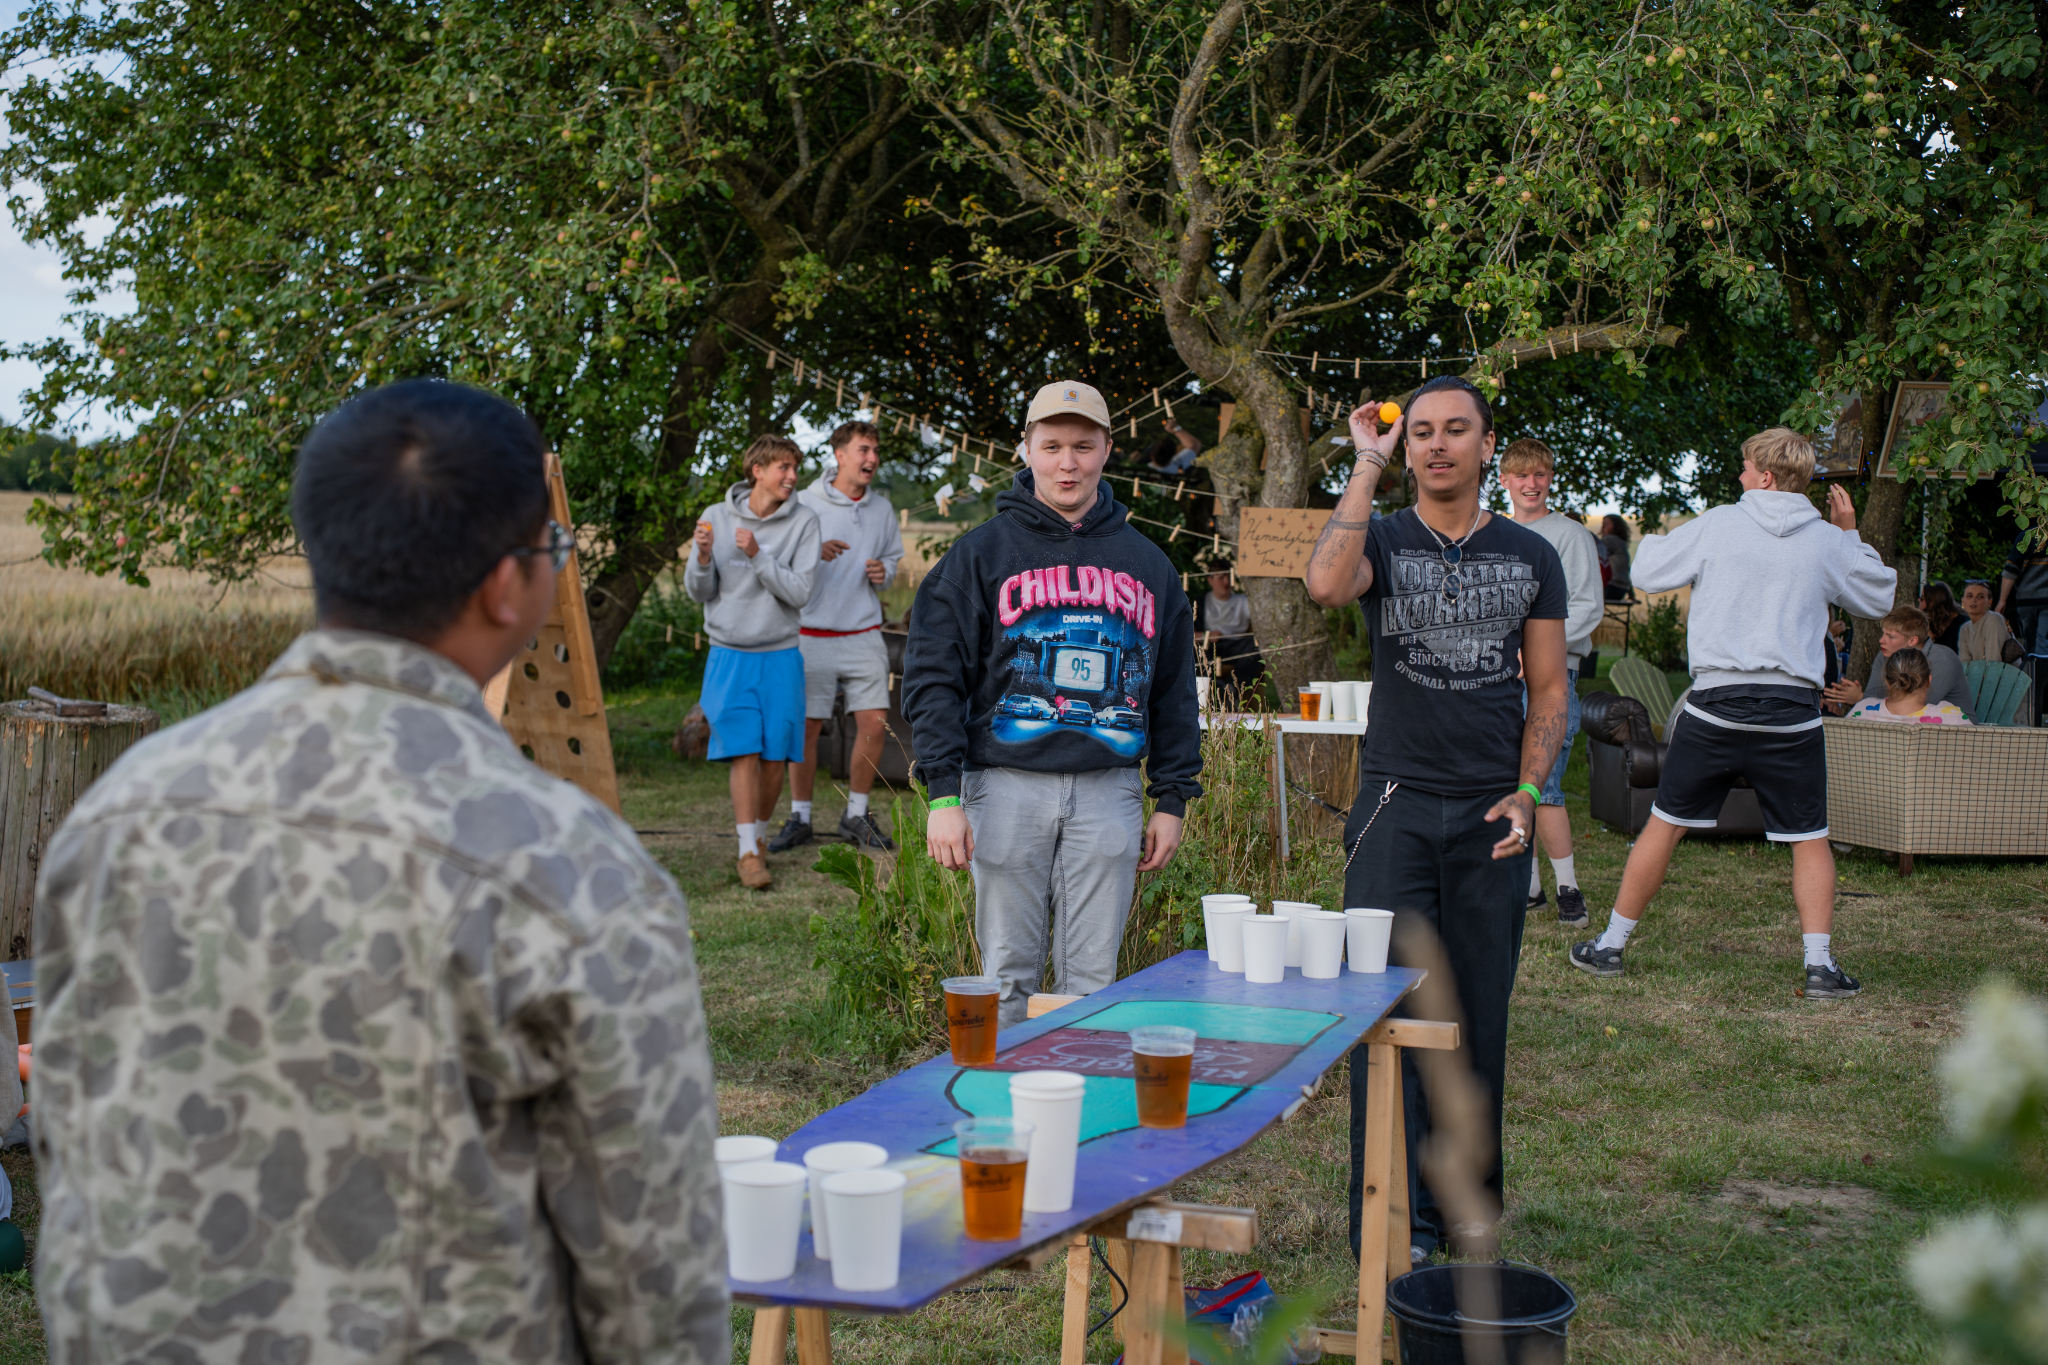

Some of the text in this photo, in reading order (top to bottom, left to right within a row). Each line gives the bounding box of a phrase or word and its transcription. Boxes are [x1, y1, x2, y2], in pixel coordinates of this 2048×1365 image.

[1397, 559, 1525, 591] DENIM
[998, 565, 1156, 639] CHILDISH
[1385, 582, 1538, 632] WORKERS
[1062, 614, 1103, 624] DRIVE-IN
[1071, 657, 1091, 682] 95
[1408, 637, 1504, 672] SINCE 95
[1394, 660, 1514, 691] ORIGINAL WORKWEAR
